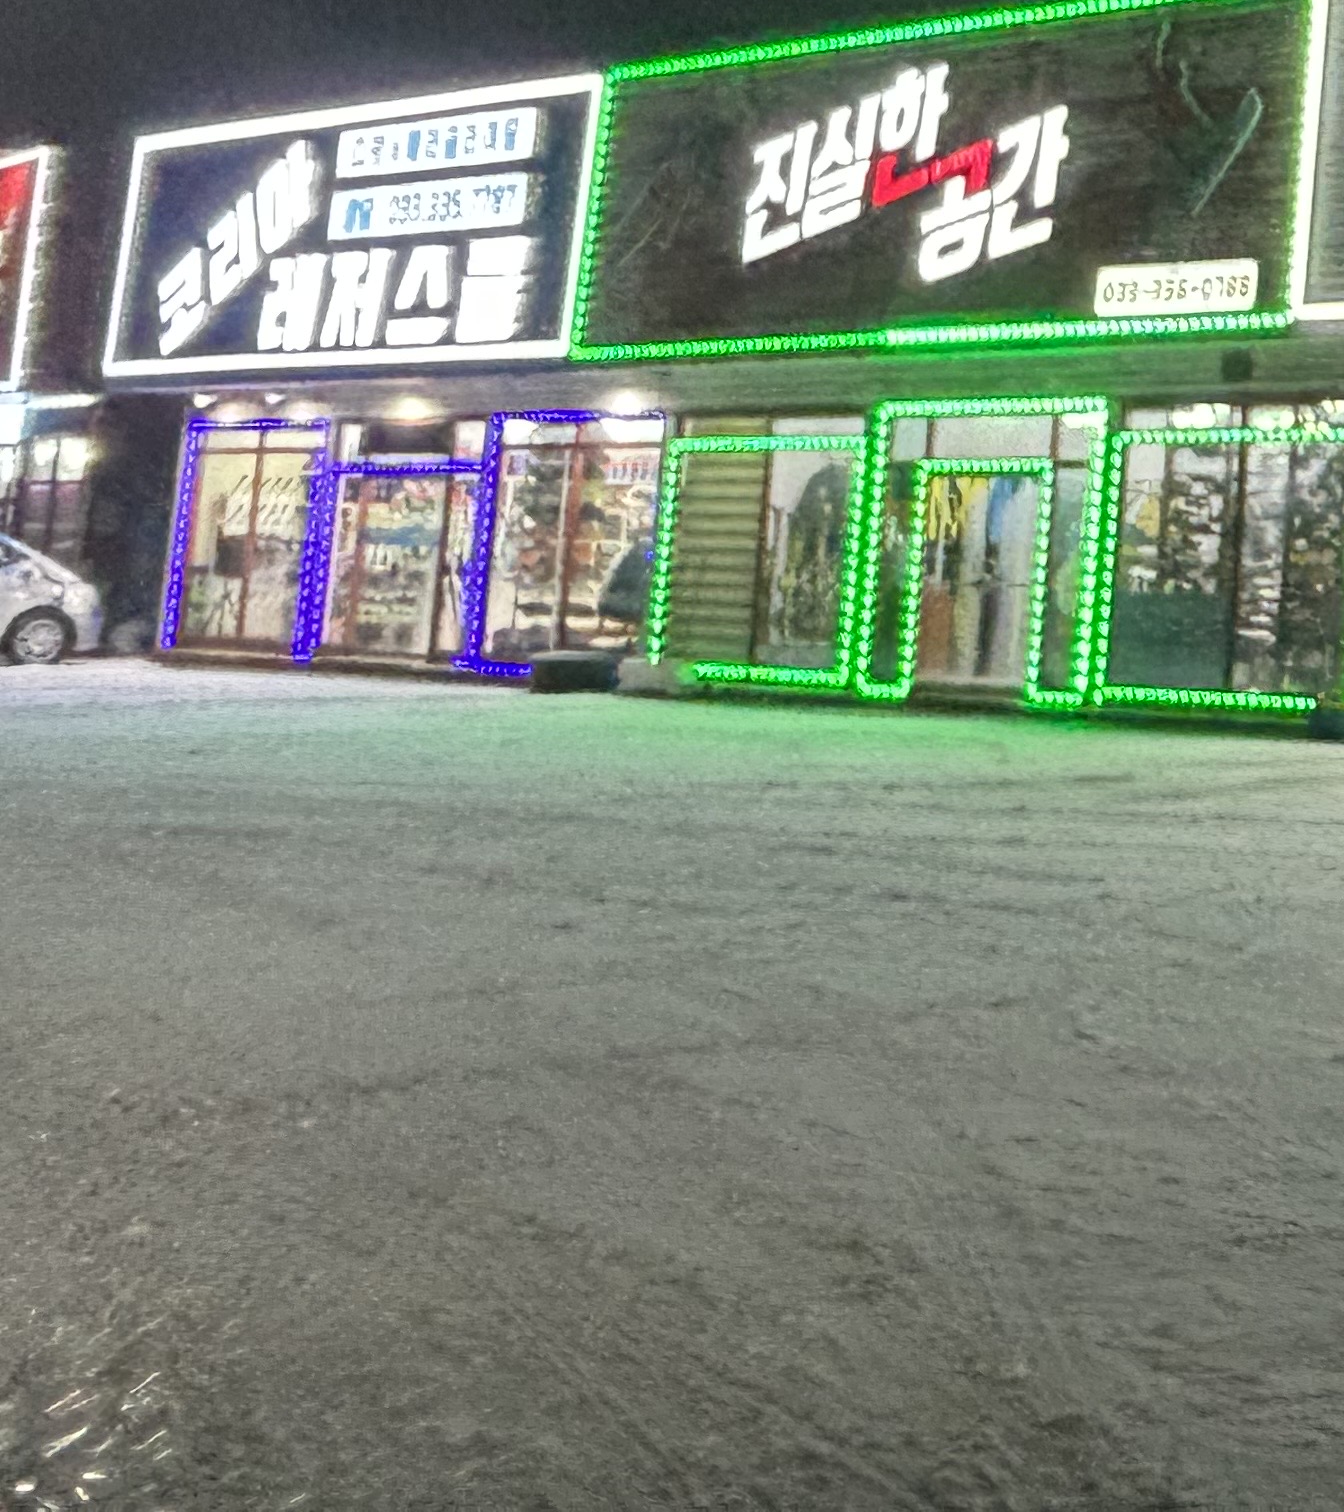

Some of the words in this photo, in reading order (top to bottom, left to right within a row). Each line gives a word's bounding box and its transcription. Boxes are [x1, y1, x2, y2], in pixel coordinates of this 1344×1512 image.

[157, 139, 316, 356] 코리아
[741, 61, 950, 265] 진실한
[917, 103, 1071, 283] 공간
